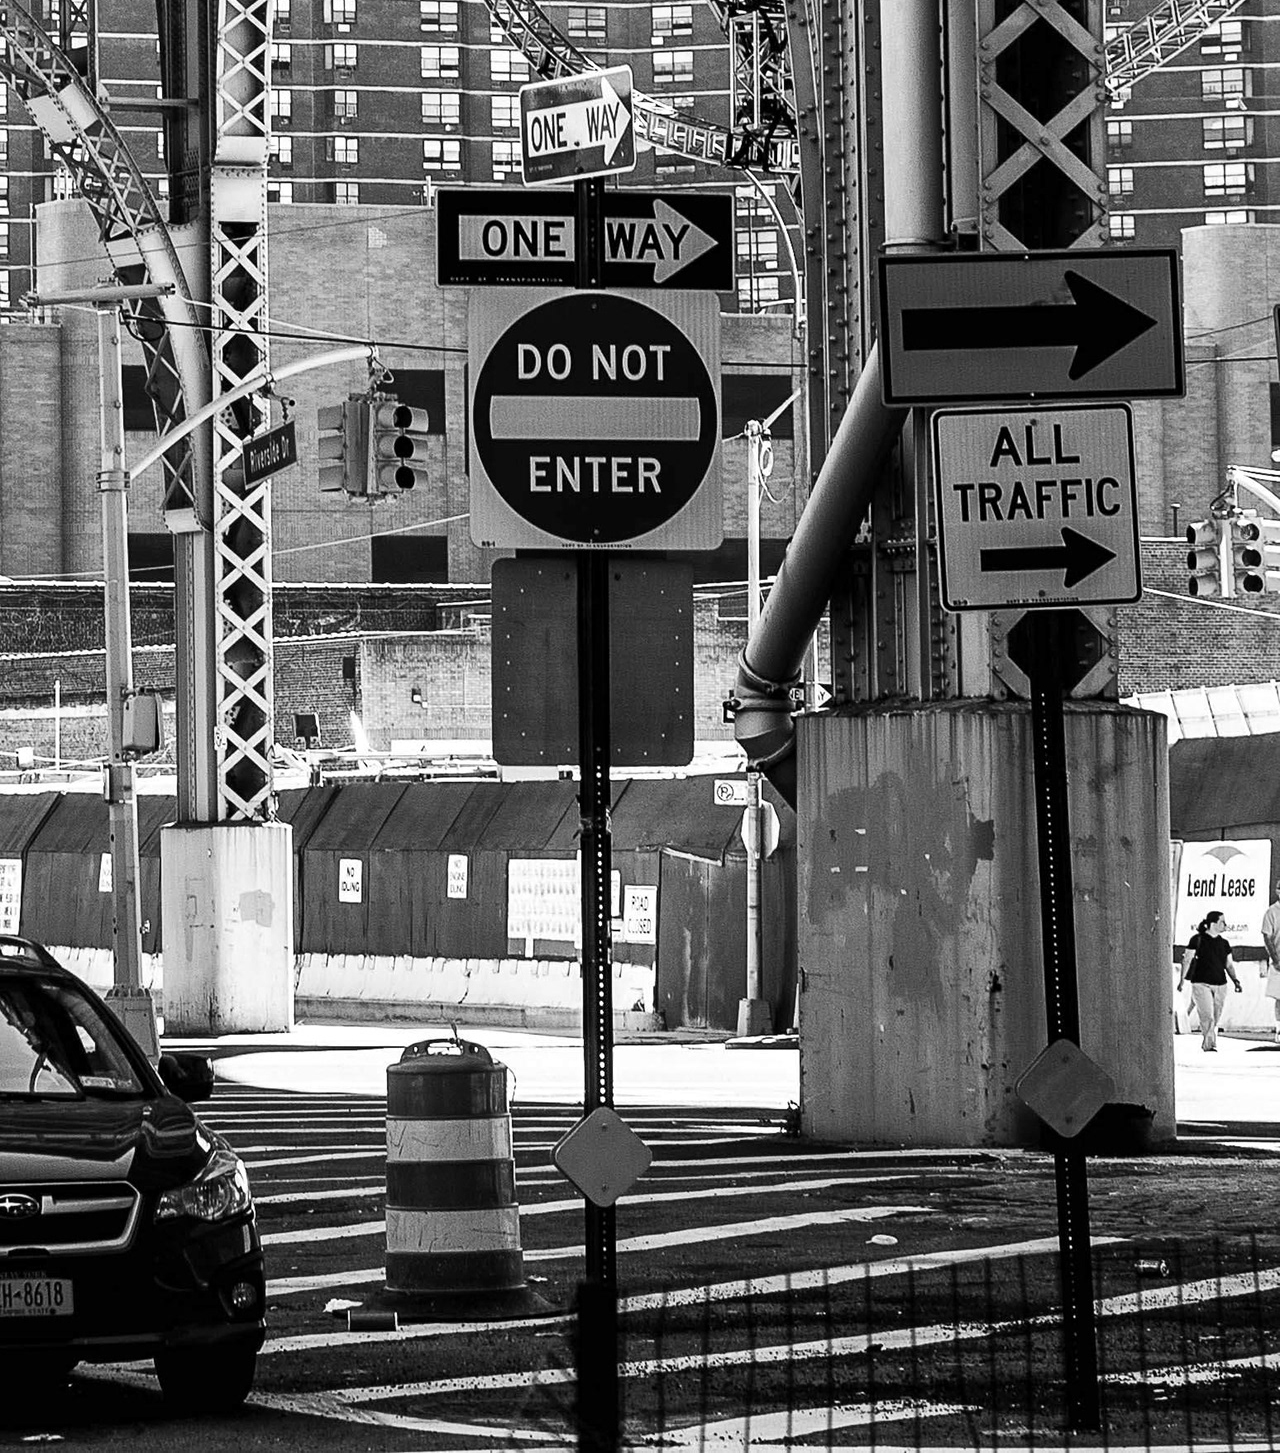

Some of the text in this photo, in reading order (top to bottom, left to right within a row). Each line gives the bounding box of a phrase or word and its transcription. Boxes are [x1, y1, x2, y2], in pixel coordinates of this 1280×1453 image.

[531, 102, 620, 152] ONE WAY
[481, 219, 690, 260] ONE WAY
[517, 344, 671, 381] DO NOT
[250, 435, 290, 473] Riverside Dr
[990, 424, 1080, 467] ALL
[529, 456, 662, 493] ENTER
[953, 477, 1121, 522] TRAFFIC
[346, 867, 354, 877] NO
[1187, 873, 1256, 897] Lend Lease
[631, 895, 649, 911] ROAD
[628, 918, 651, 934] CLOSED
